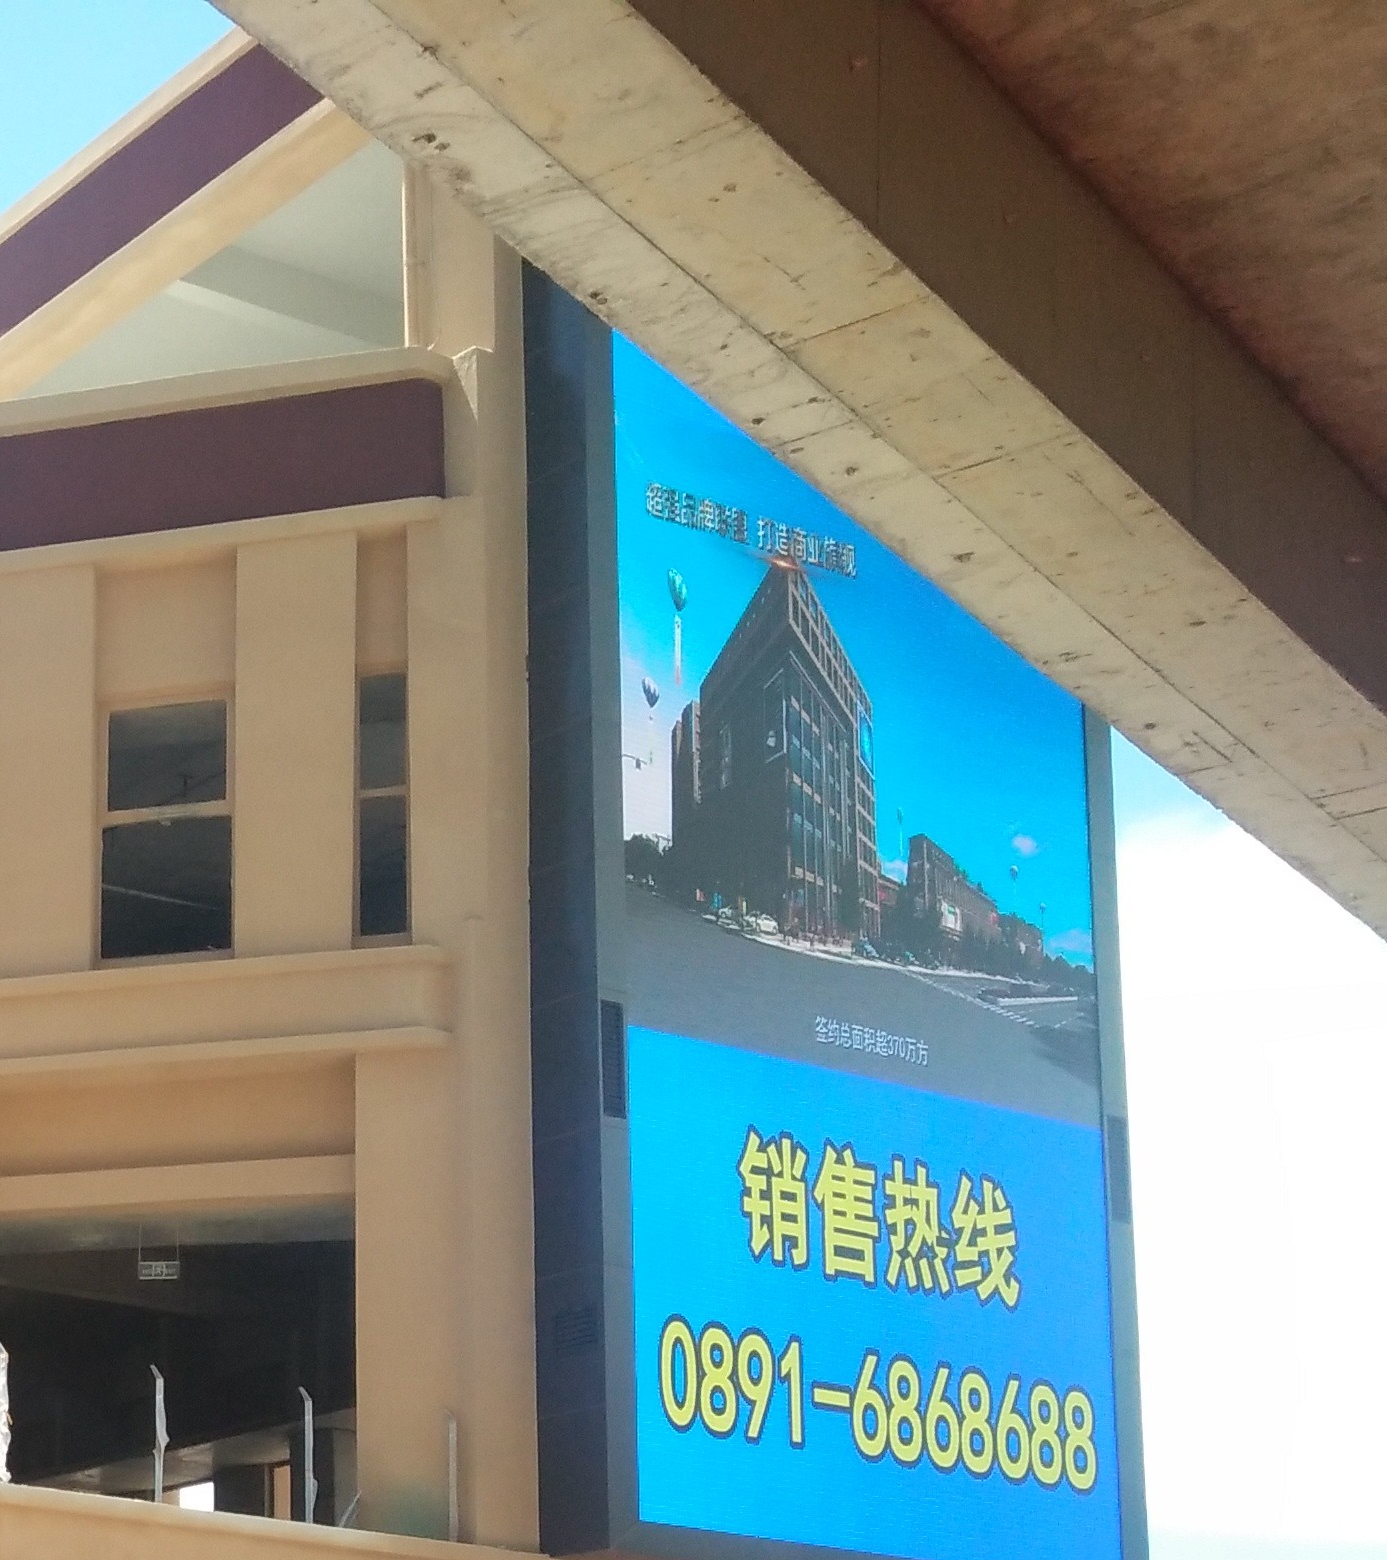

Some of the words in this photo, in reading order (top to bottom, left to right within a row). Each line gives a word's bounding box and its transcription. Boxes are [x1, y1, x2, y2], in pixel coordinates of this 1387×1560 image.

[814, 1014, 929, 1067] 签约总面积超370万方
[737, 1124, 1022, 1310] 销售热线
[658, 1312, 1099, 1493] 0891-6868688
